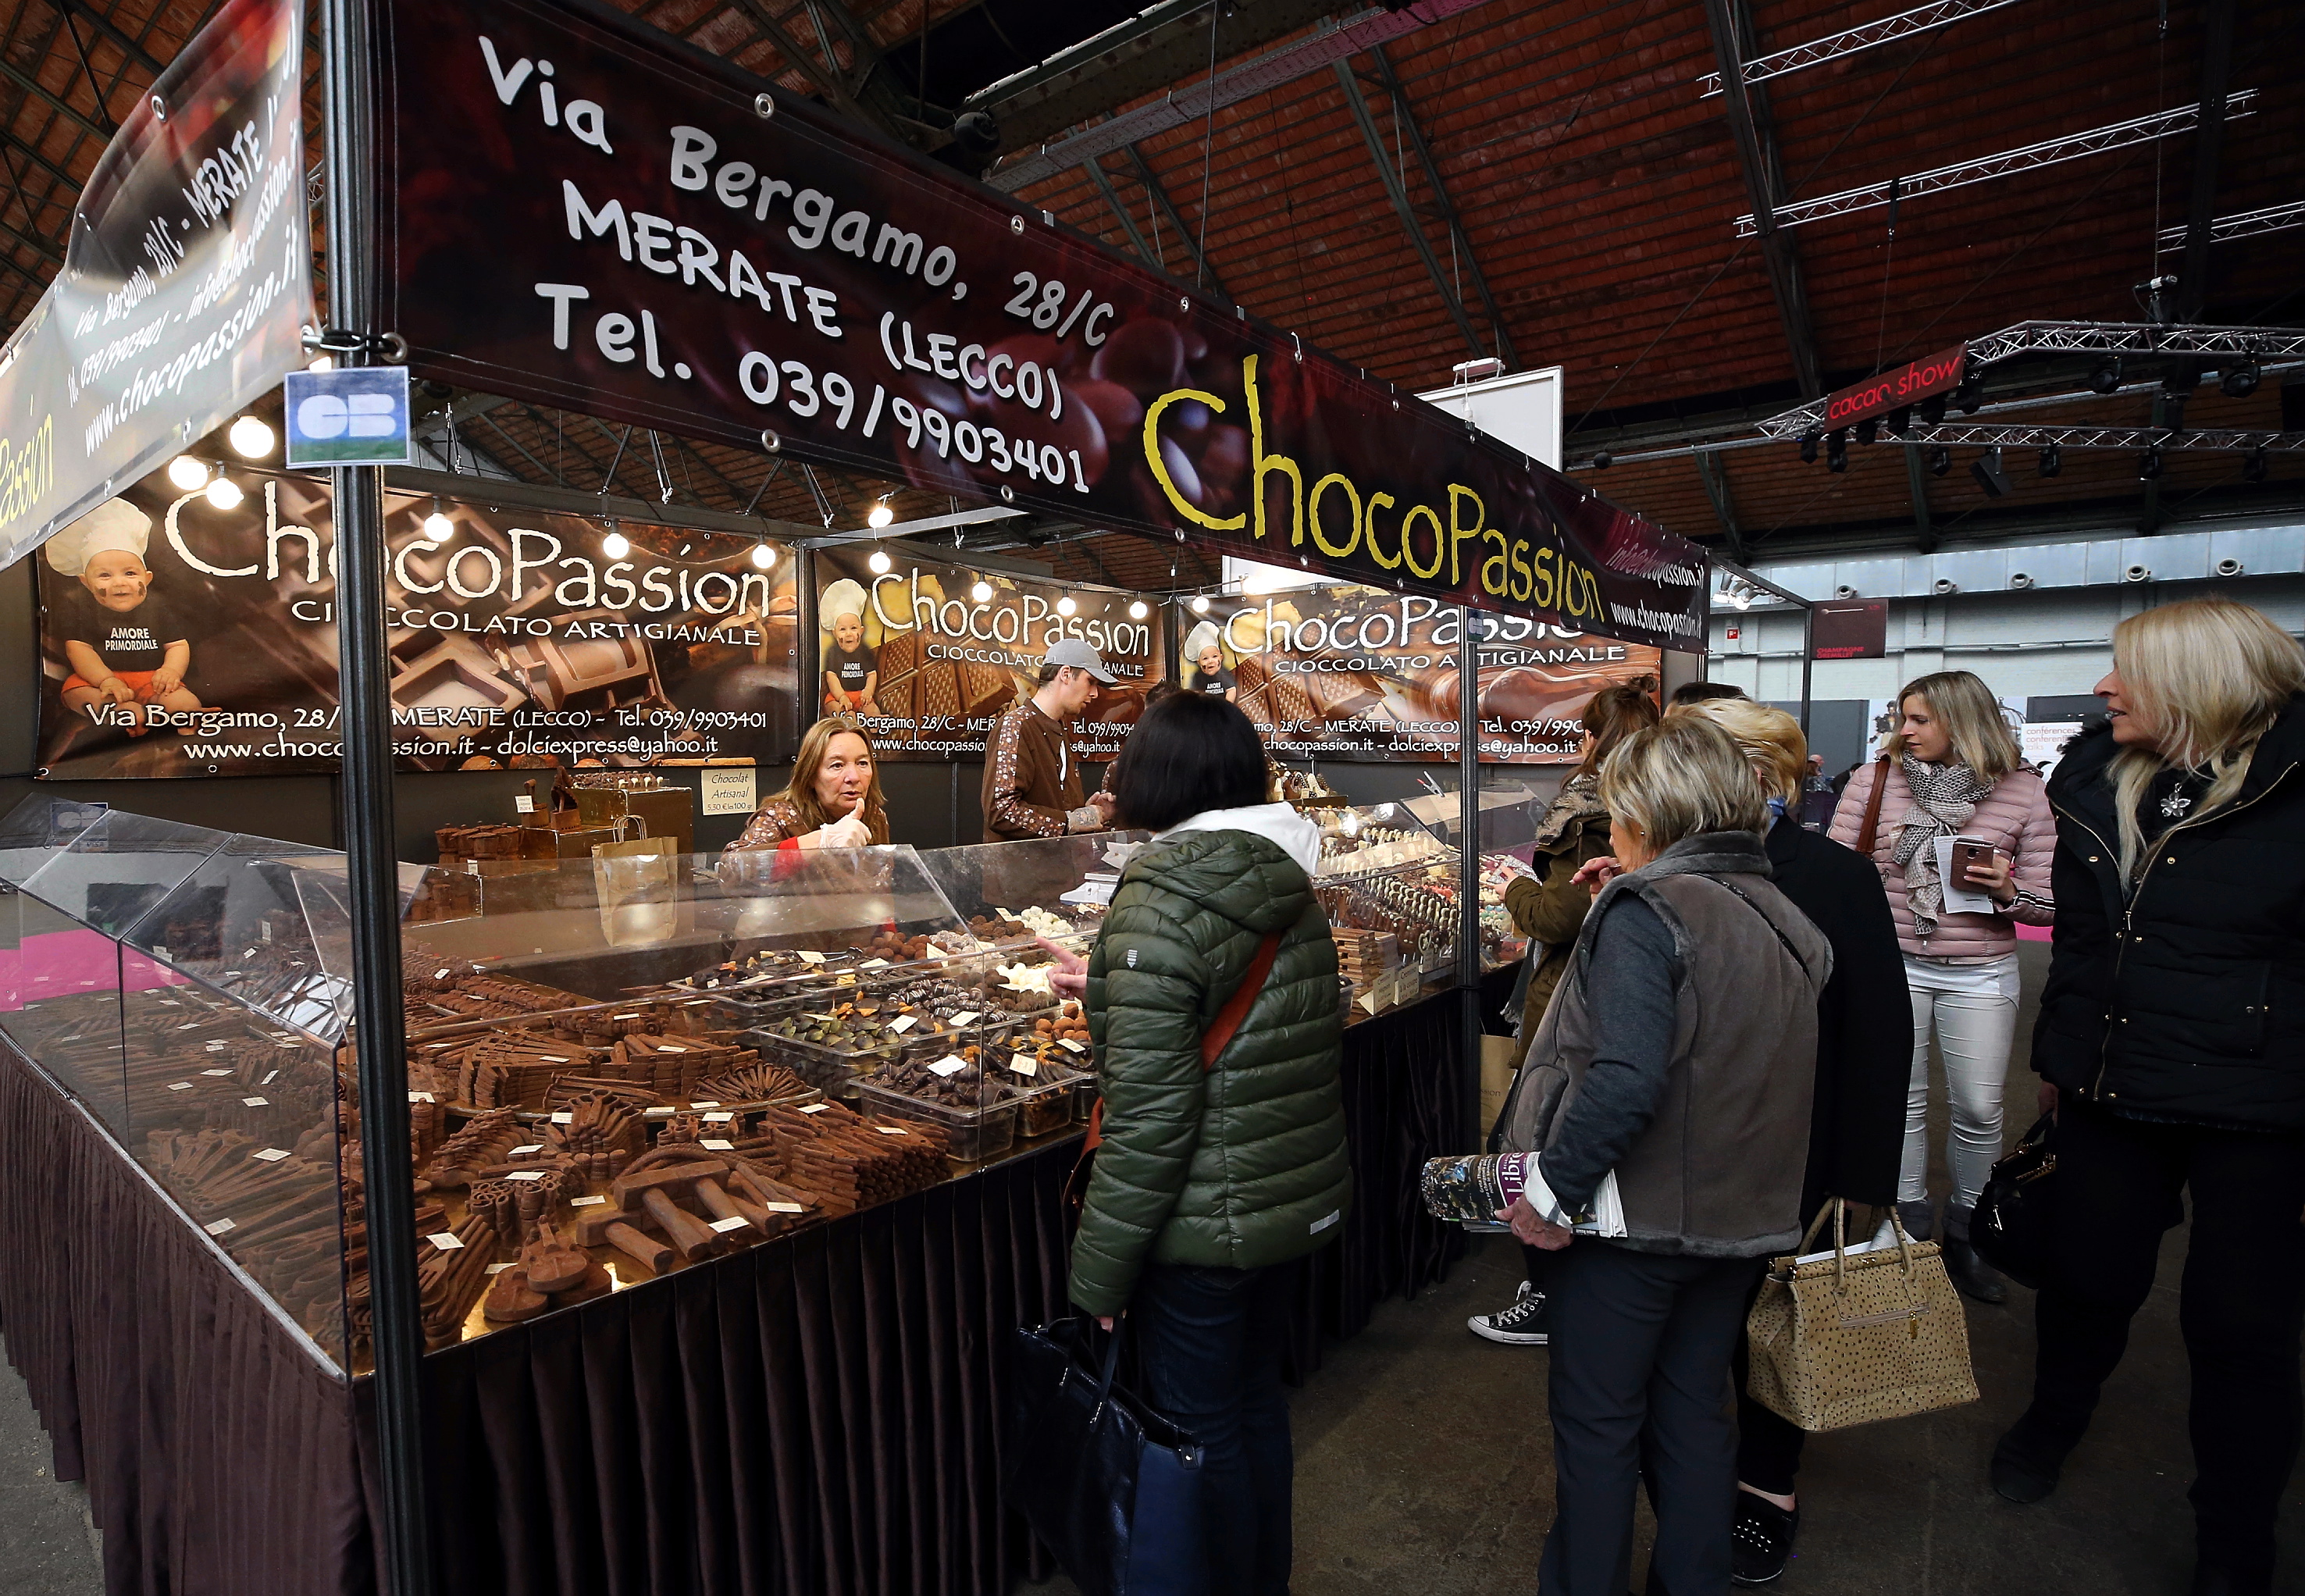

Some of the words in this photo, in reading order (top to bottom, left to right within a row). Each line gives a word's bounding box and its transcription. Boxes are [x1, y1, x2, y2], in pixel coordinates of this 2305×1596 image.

[478, 35, 613, 155] Via
[670, 125, 968, 301] Bergamo,
[1004, 272, 1114, 347] 28/C
[74, 305, 98, 340] Via
[182, 119, 263, 229] MERATE
[563, 180, 843, 337] MERATE
[880, 312, 1064, 420] (LECCO)
[80, 310, 169, 389] 039/9903401
[85, 216, 298, 458] www.chocopassion.it
[535, 283, 692, 379] Tel.
[739, 351, 1090, 494] 039/9903401
[1829, 383, 1891, 419] cacao
[1897, 356, 1961, 395] show
[1142, 353, 1605, 623] ChocoPassion
[165, 480, 770, 618] ChcoPassion
[291, 600, 553, 636] CICOLATO
[564, 621, 761, 646] ARTIGIANALE
[871, 567, 1149, 657] ChocoPassion
[1610, 599, 1702, 640] www.chocopassion.it
[105, 639, 159, 651] PRIMORDIALE
[110, 627, 150, 639] AMORE
[1274, 654, 1429, 673] CIOCCOLATO
[1438, 645, 1626, 668] ATIGIANALE
[146, 704, 287, 736] Bergamo,
[294, 706, 341, 730] 28/
[391, 707, 506, 726] MERATE
[513, 709, 592, 729] (LECCO)
[615, 704, 645, 727] Tel.
[650, 708, 767, 731] 039/9903401
[857, 712, 918, 734] Bergamo,
[921, 714, 955, 732] 28/C
[966, 718, 996, 732] MER
[1071, 717, 1087, 734] Tel.
[1280, 719, 1312, 734] 28/C
[1324, 720, 1391, 735] MERATE
[1395, 720, 1460, 735] (LECCO)
[1479, 715, 1508, 734] Tel.
[183, 732, 475, 759] www.chocossion.it
[497, 729, 719, 764] dolciexpress@yahoo.it
[871, 732, 986, 756] www.chocopassio
[1263, 734, 1374, 757] chocopassion.it
[711, 771, 749, 784] Chocolat
[711, 786, 750, 800] Artisanal
